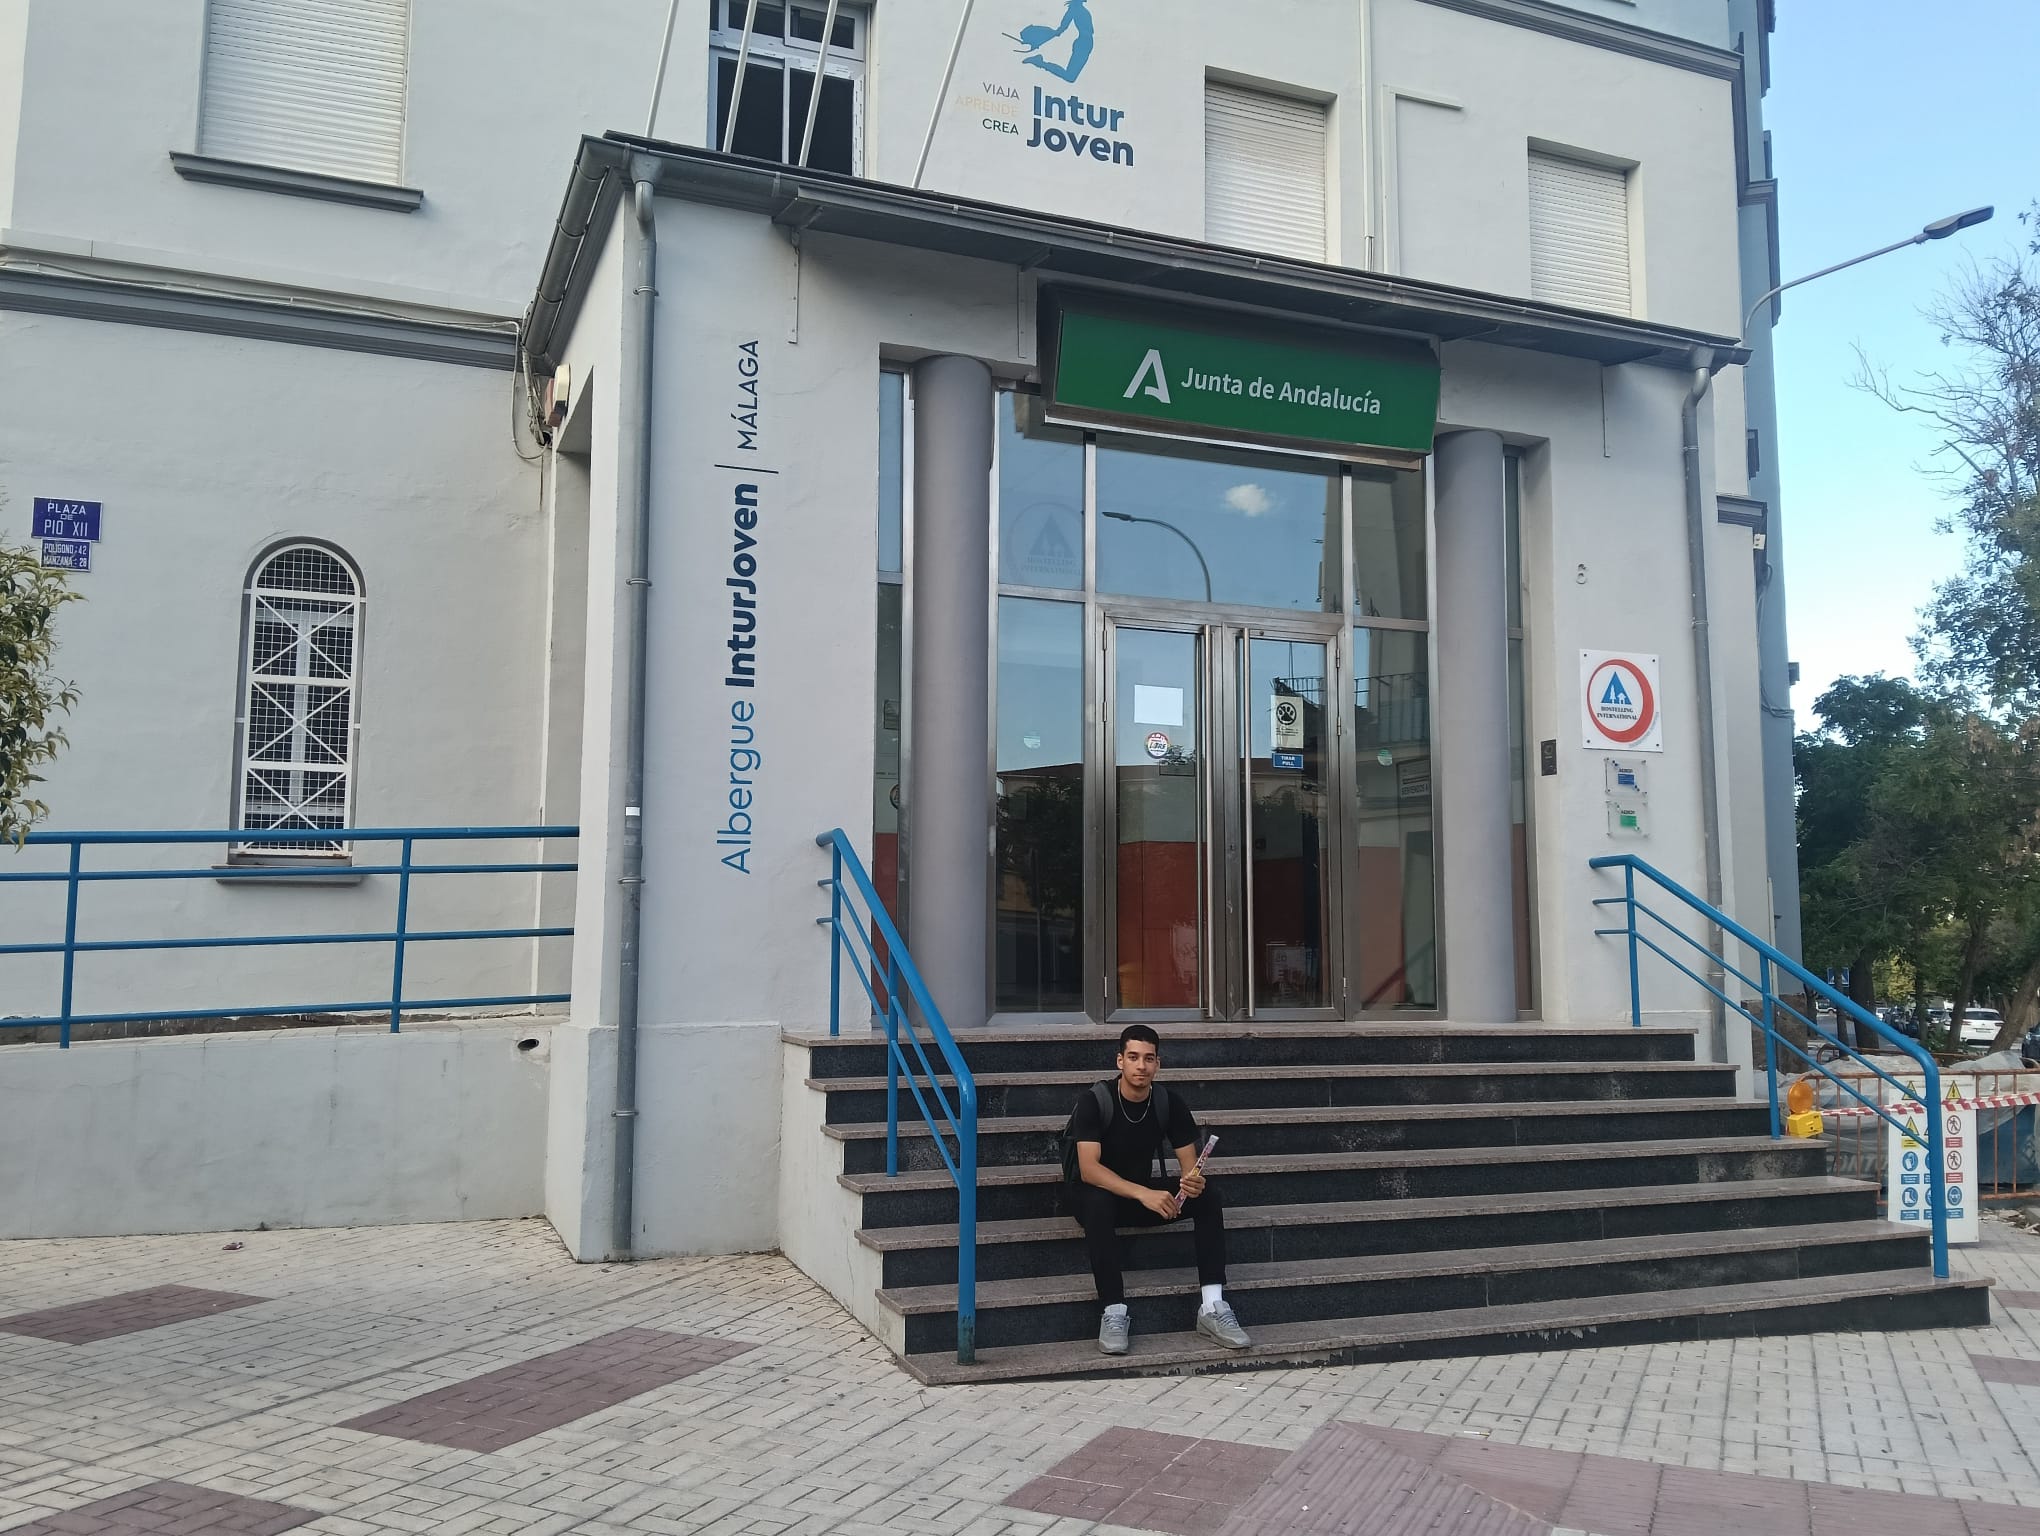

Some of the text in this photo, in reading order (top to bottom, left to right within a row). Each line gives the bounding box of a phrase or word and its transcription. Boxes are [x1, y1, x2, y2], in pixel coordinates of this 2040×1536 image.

[982, 81, 1020, 100] VIAJA
[955, 95, 1020, 117] APRENDE
[1033, 85, 1125, 132] Intur
[982, 118, 1019, 135] CREA
[1026, 117, 1134, 166] Joven
[1180, 367, 1381, 415] Junta de Andalucía
[47, 502, 86, 515] PLAZA
[44, 519, 88, 537] PIO XII
[716, 340, 762, 874] Albergue InturJoven MÁLAGA
